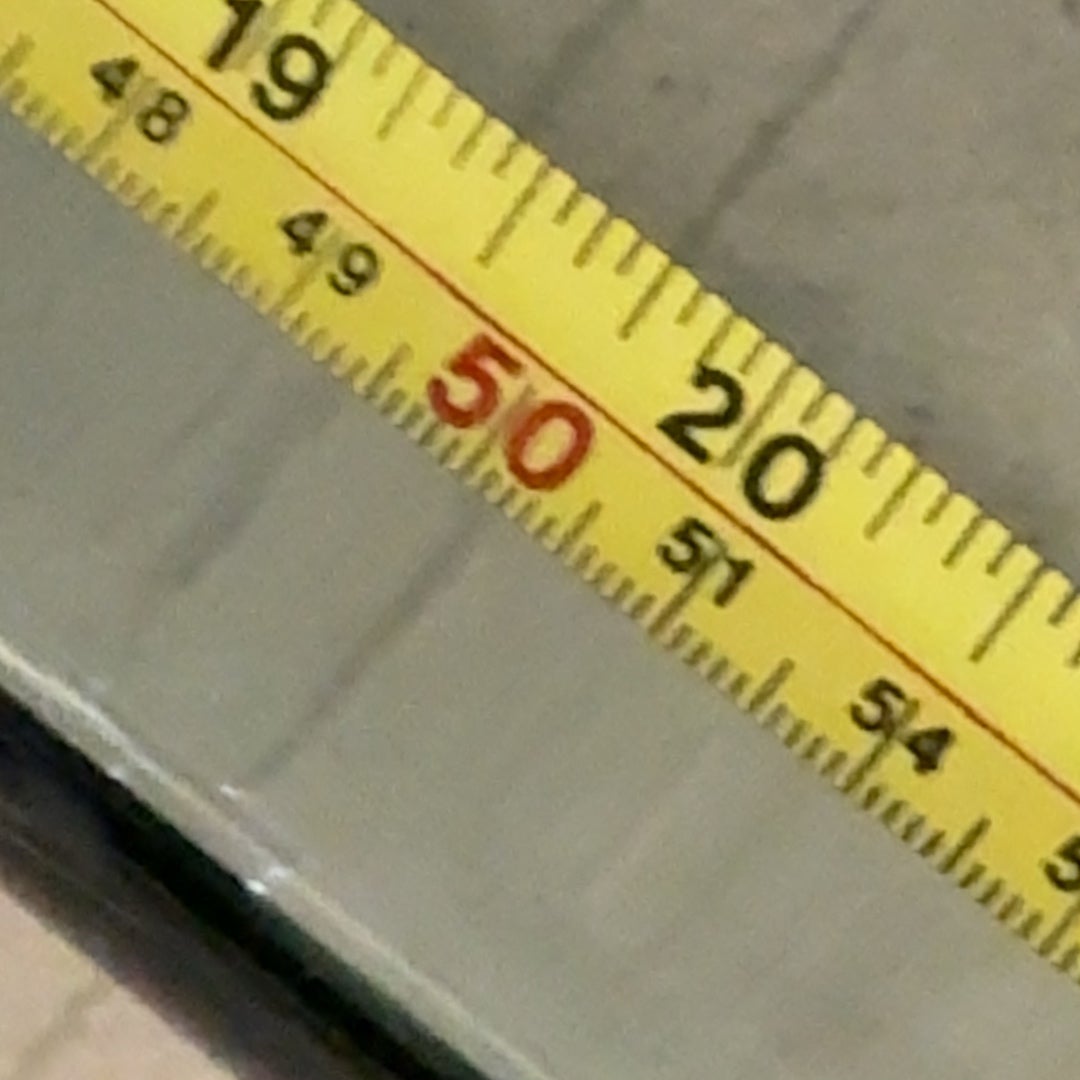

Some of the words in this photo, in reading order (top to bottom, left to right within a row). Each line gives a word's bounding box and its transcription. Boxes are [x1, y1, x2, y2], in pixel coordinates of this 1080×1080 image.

[90, 56, 190, 145] 48
[205, 0, 332, 122] 19
[278, 209, 381, 297] 49
[426, 333, 596, 492] 50
[656, 364, 825, 522] 20
[656, 517, 756, 607] 51
